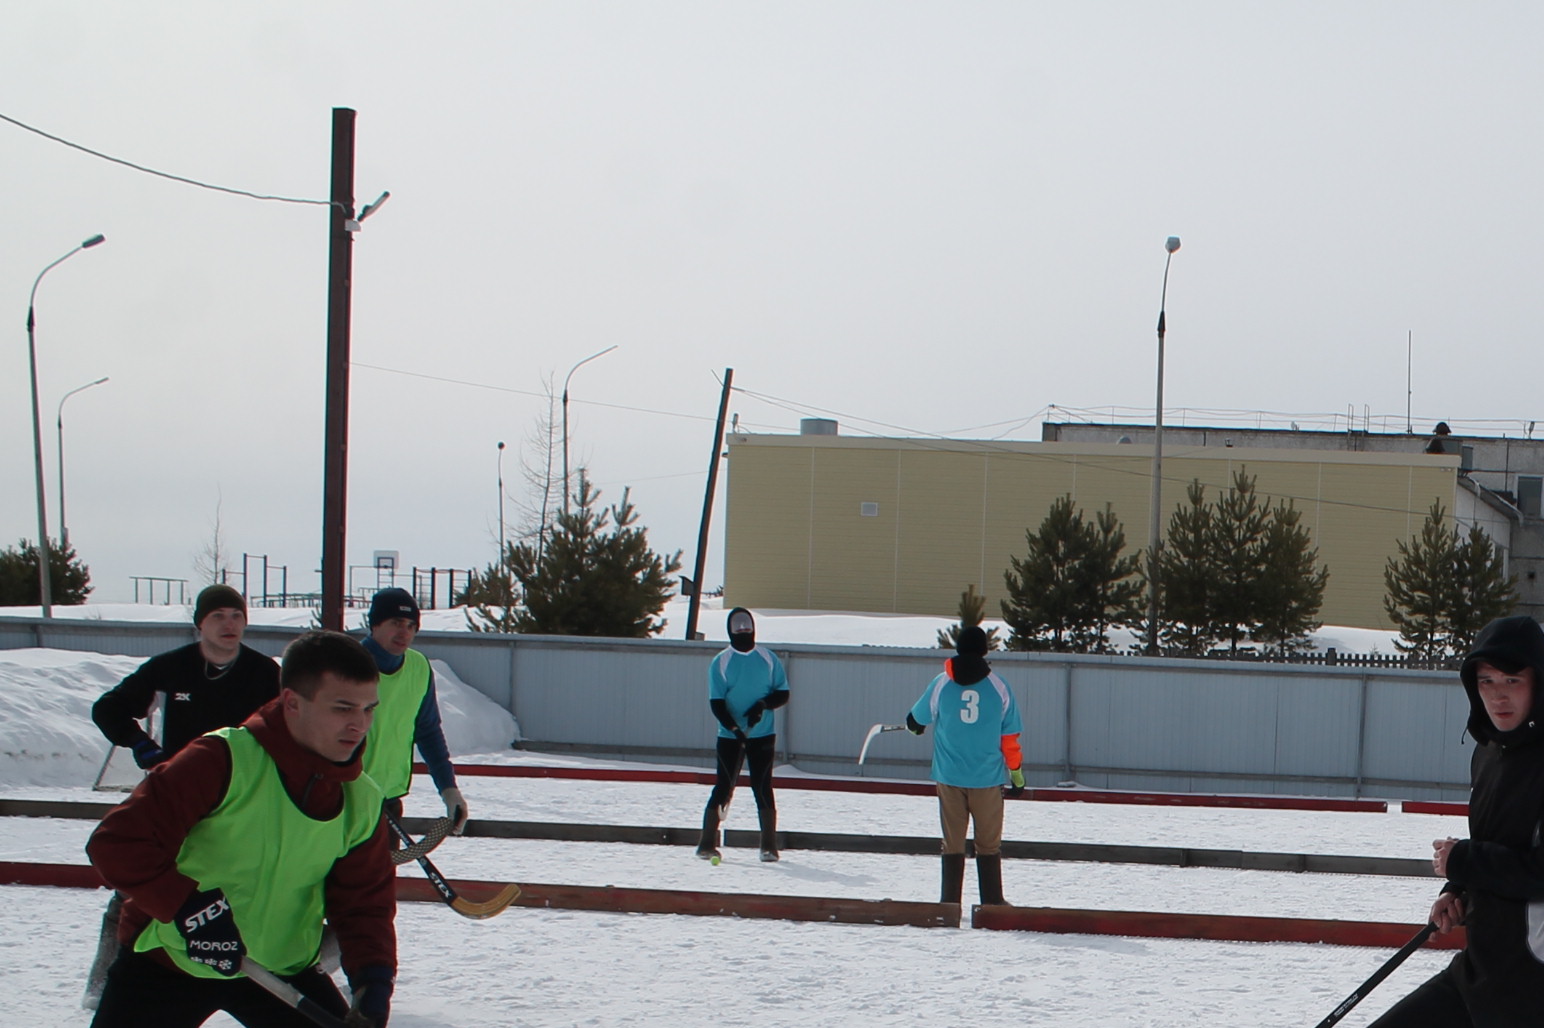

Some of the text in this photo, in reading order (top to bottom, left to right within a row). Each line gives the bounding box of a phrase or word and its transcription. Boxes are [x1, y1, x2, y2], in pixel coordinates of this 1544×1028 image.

[960, 689, 980, 725] 3
[429, 872, 453, 898] STEX
[185, 896, 229, 933] STEX
[189, 940, 238, 951] MOROZ
